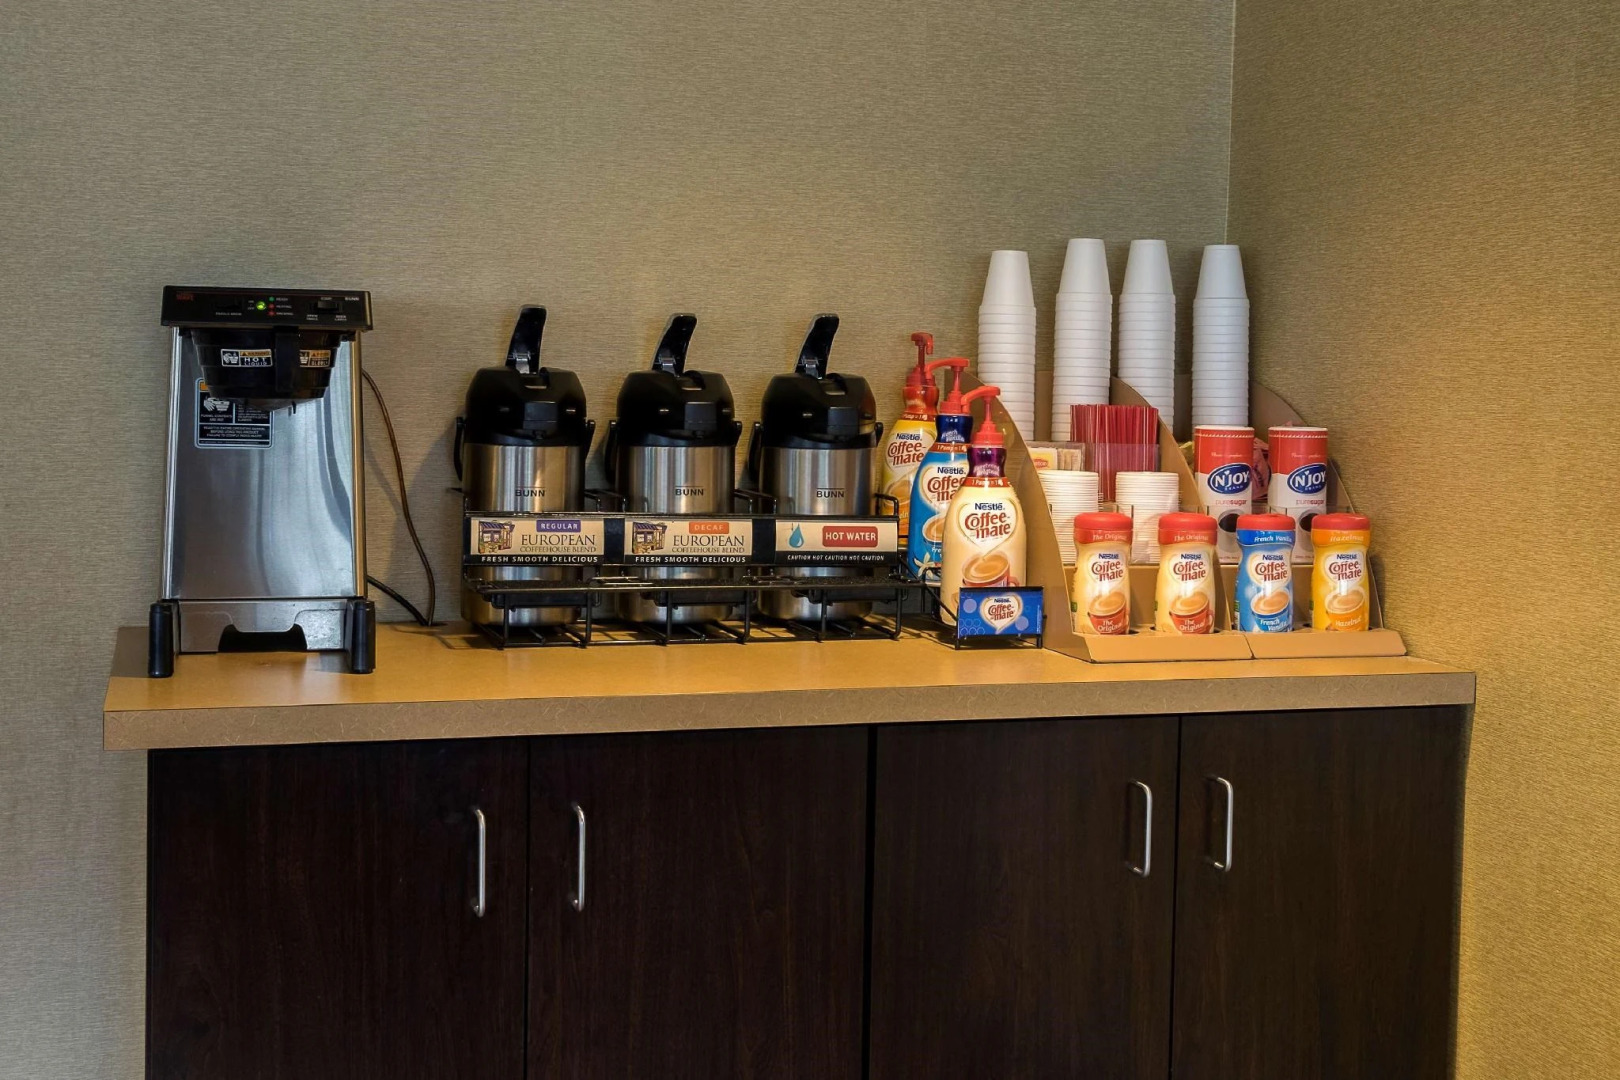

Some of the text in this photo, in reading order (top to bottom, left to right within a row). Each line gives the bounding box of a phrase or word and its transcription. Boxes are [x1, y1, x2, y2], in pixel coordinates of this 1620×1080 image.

[893, 452, 924, 465] mate
[937, 490, 958, 501] ma
[825, 532, 876, 540] HOT WATER
[976, 523, 1010, 538] mate
[522, 534, 595, 546] EUROPEAN
[673, 535, 745, 546] EUROPEAN
[1100, 570, 1123, 582] mate
[1182, 570, 1206, 581] mate
[1264, 570, 1288, 582] mate
[1338, 569, 1361, 581] mate
[994, 610, 1014, 620] mate
[1098, 621, 1122, 632] Original
[1180, 620, 1205, 632] Original
[1335, 616, 1361, 626] Hazelnut
